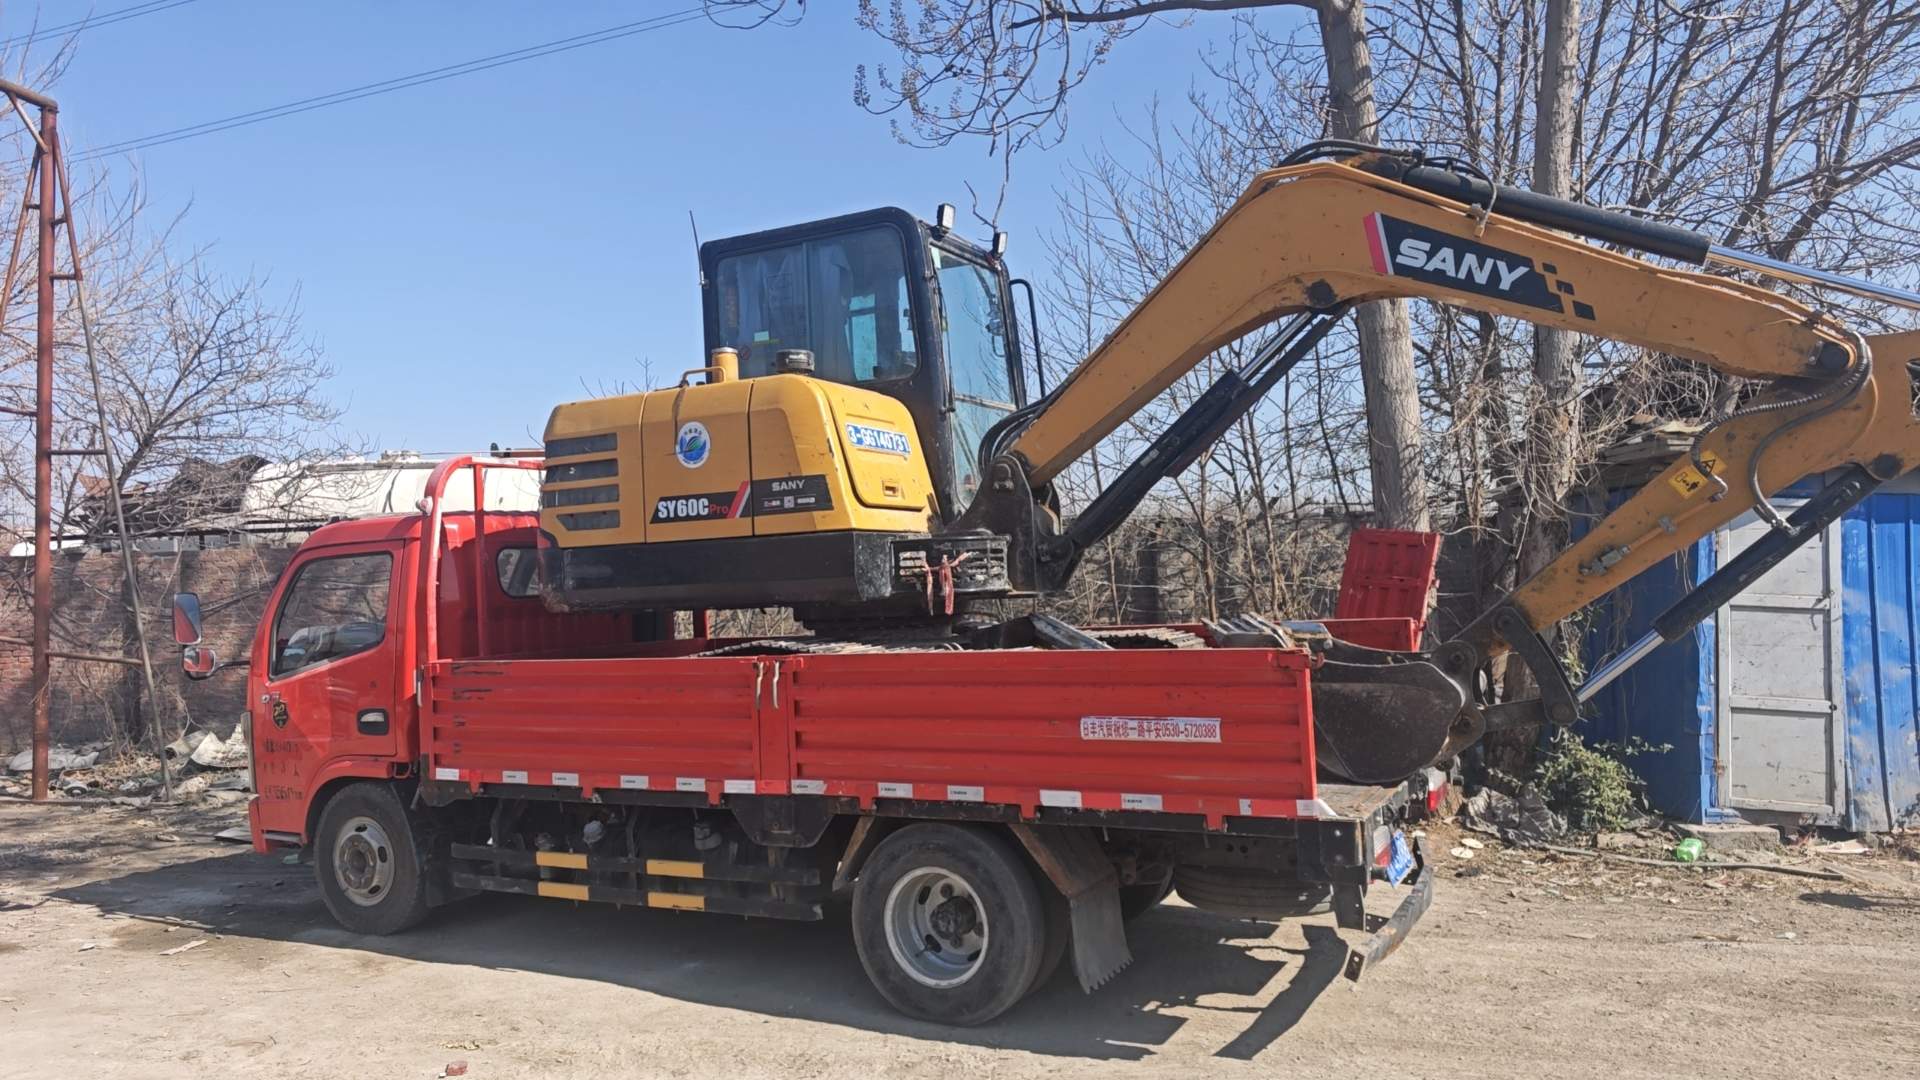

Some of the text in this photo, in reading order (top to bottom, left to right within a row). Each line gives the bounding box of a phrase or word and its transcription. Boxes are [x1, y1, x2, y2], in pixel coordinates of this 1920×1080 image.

[1395, 238, 1530, 291] SANY
[771, 479, 805, 492] SANY
[658, 498, 709, 519] SY60C
